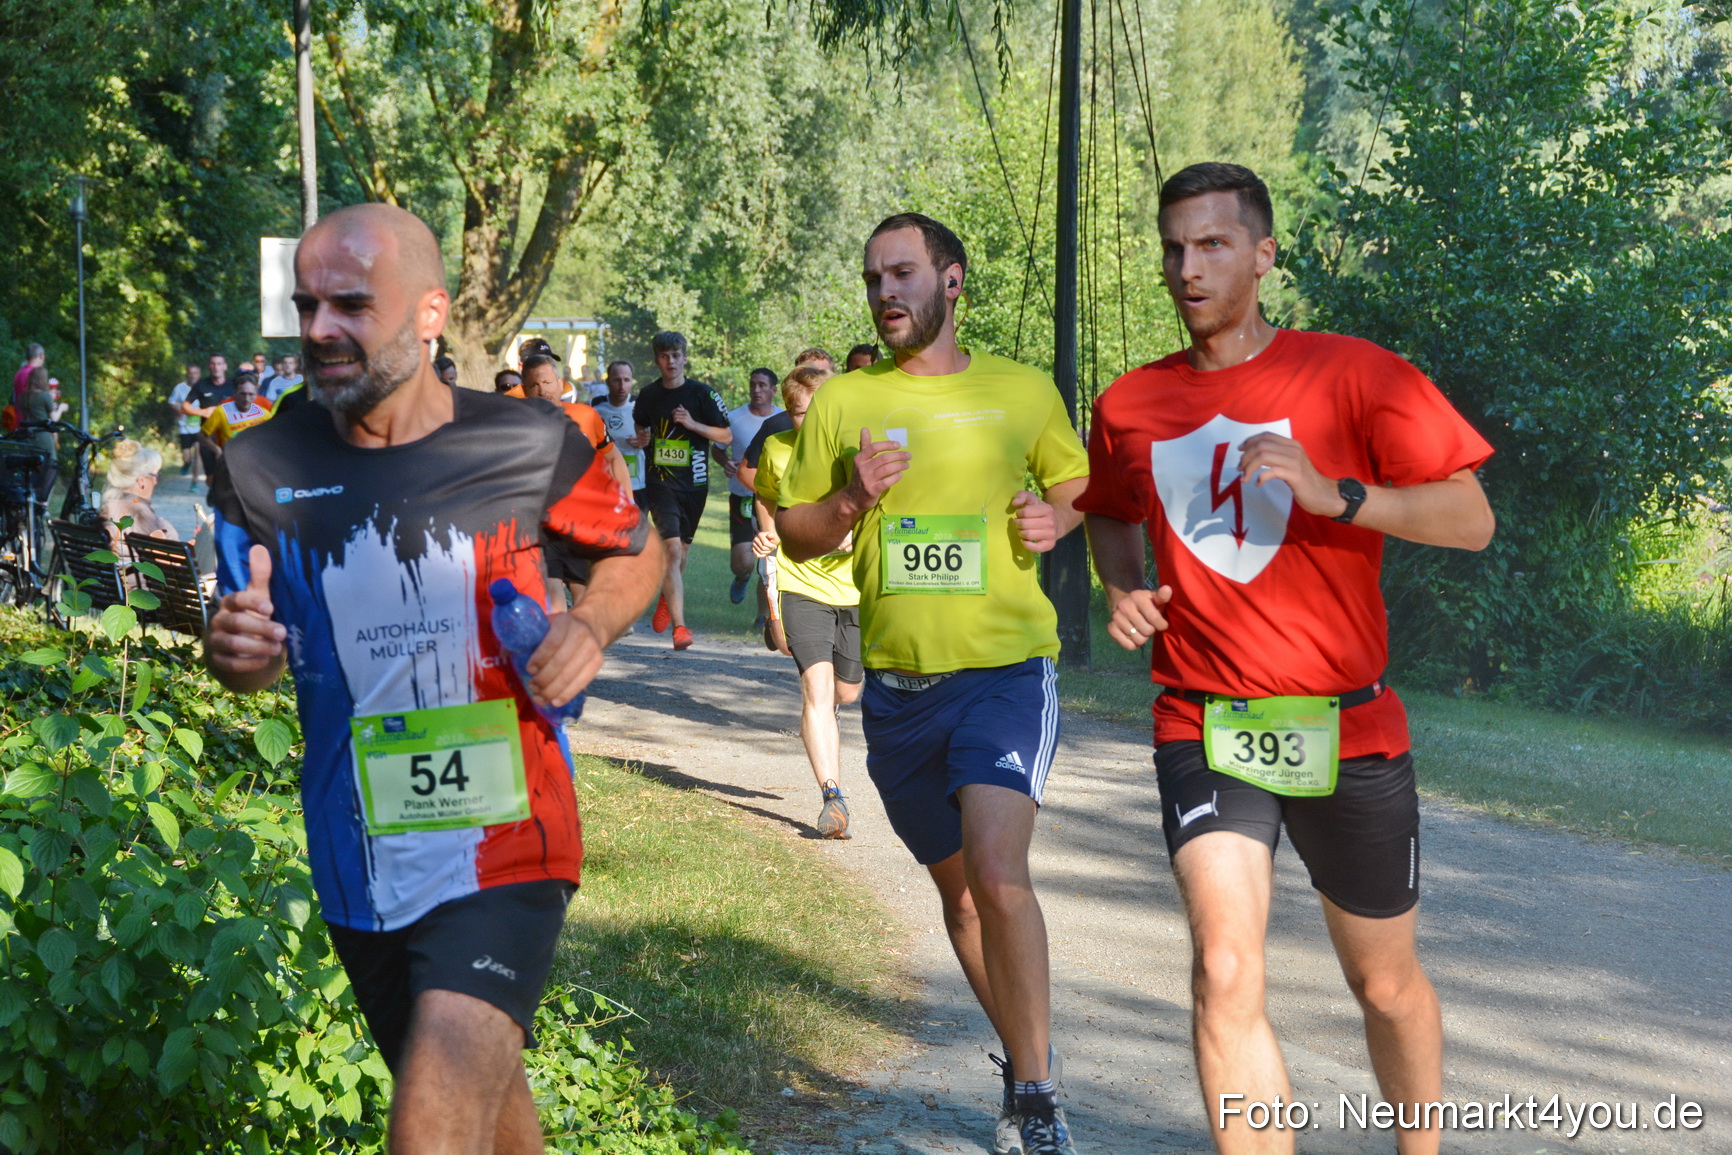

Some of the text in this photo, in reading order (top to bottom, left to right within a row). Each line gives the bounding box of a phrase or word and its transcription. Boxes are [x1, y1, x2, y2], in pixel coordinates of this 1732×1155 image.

[658, 448, 685, 459] 1430
[903, 543, 963, 572] 966
[908, 573, 960, 582] Stark Philipp
[355, 618, 451, 644] AUTOHAUS
[370, 639, 438, 661] MÜLLER
[1233, 731, 1306, 767] 393
[410, 749, 470, 796] 54
[995, 760, 1026, 775] adidas
[1278, 768, 1314, 780] Jürgen
[404, 795, 484, 811] Plank Werner
